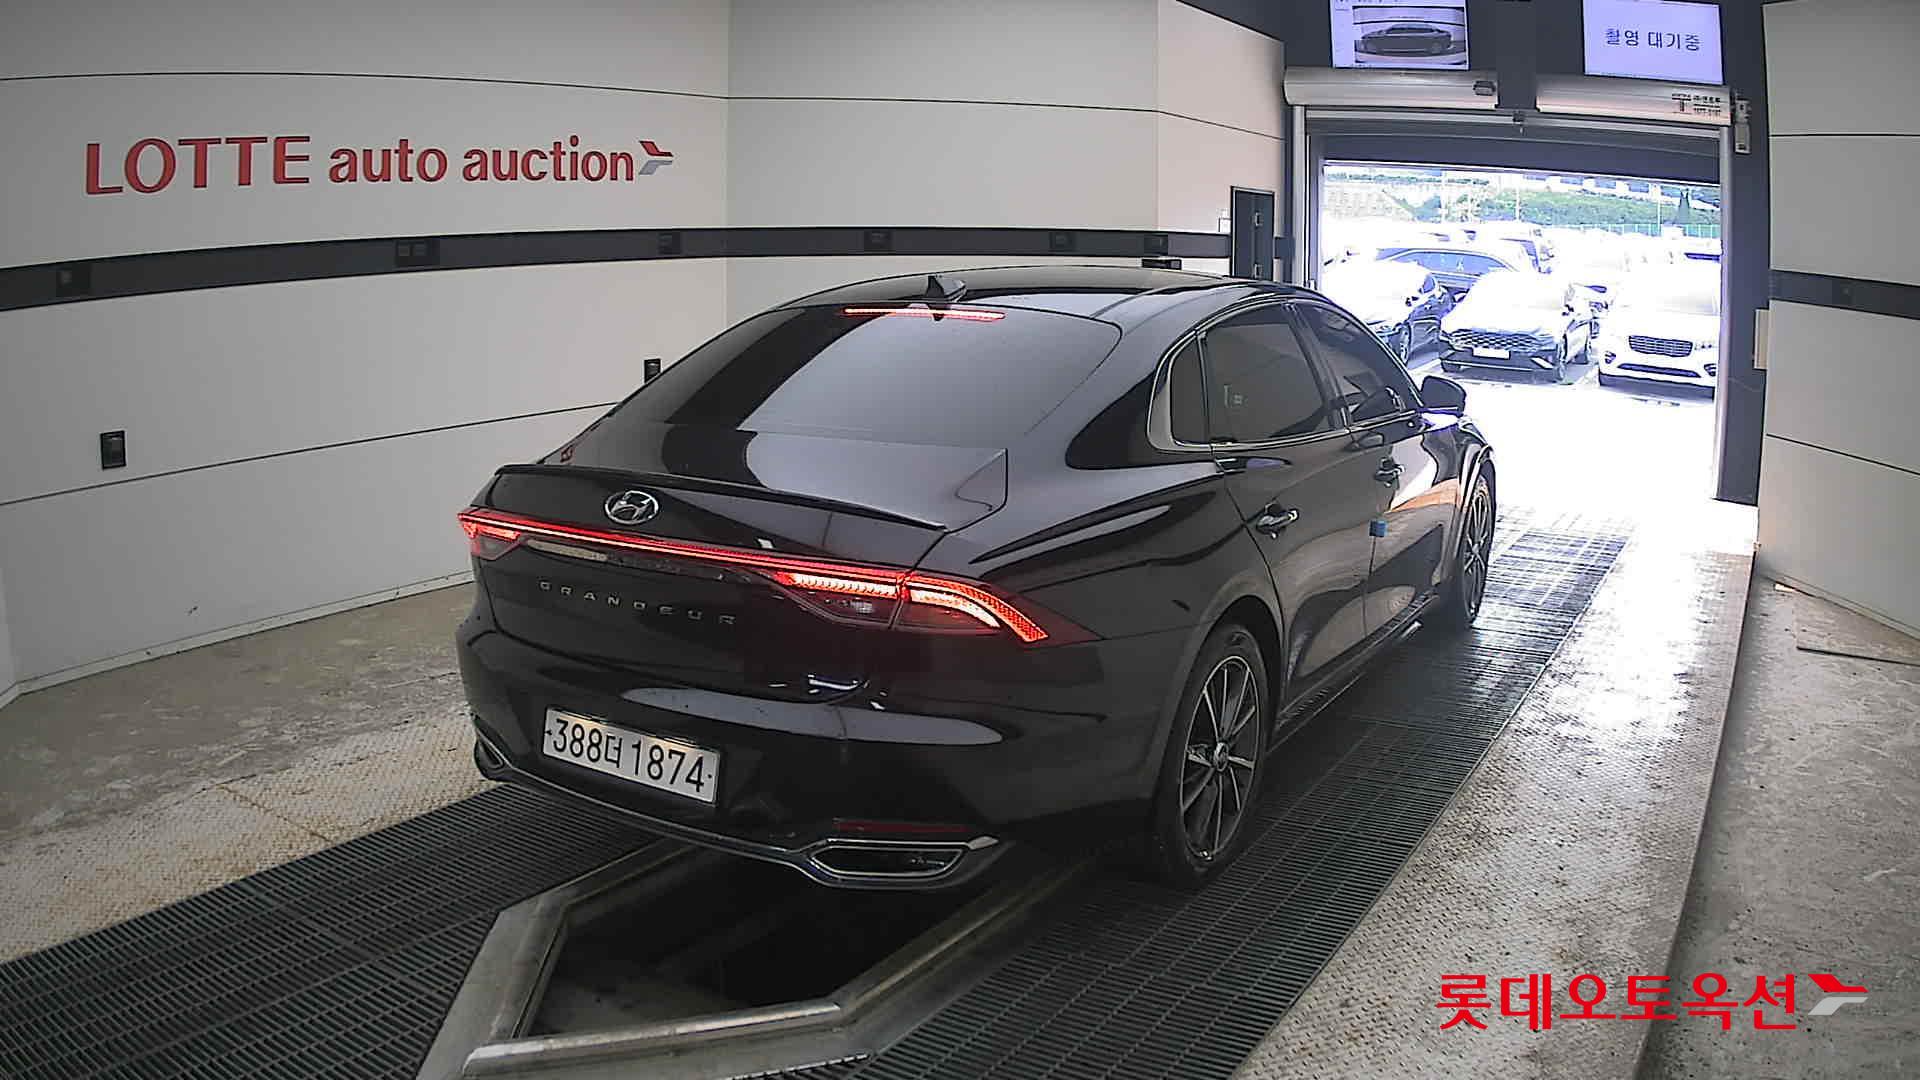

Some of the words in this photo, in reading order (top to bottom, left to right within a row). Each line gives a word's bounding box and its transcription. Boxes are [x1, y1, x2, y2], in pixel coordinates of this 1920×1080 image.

[1648, 32, 1700, 51] 대기중
[86, 135, 311, 195] LOTTE
[328, 138, 448, 183] auto
[461, 135, 634, 182] auction
[539, 580, 736, 625] GRANDEUR
